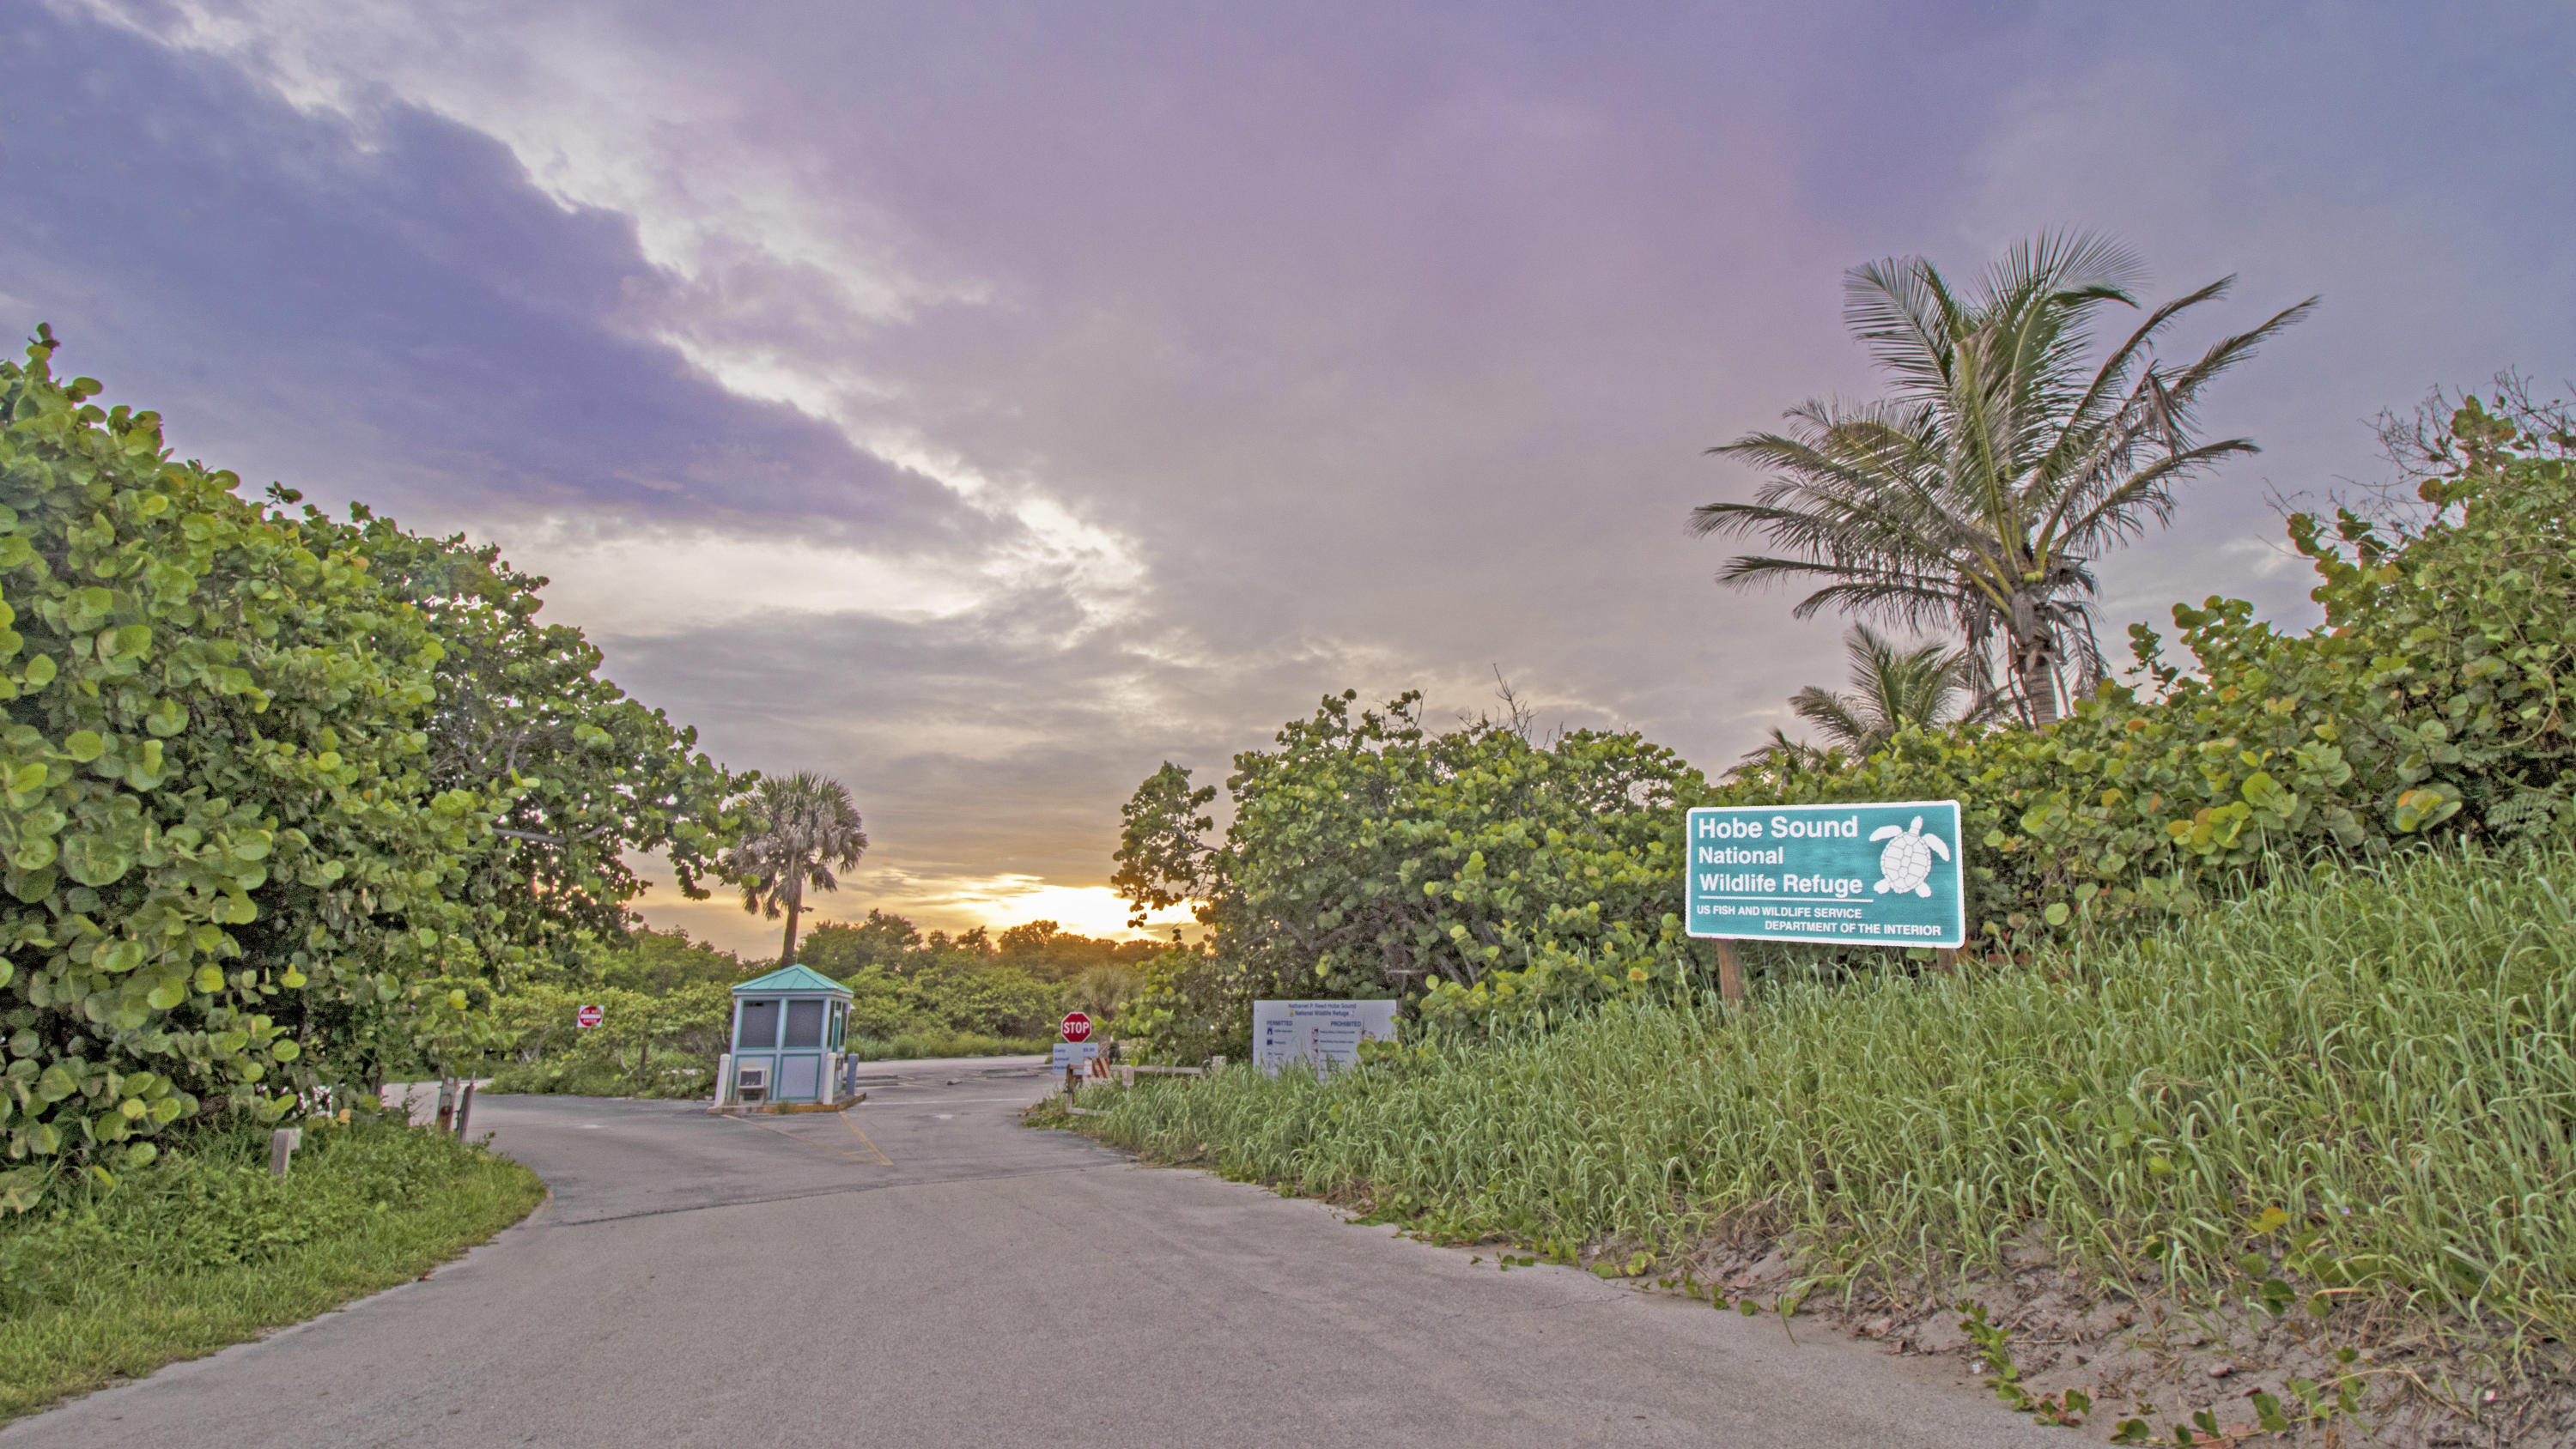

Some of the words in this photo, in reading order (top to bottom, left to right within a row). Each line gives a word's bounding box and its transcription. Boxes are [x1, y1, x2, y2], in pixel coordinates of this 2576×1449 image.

[1698, 816, 1763, 839] Hobe
[1771, 815, 1858, 839] Sound
[1698, 846, 1784, 864] National
[1699, 873, 1777, 893] Wildlife
[1783, 874, 1863, 899] Refuge
[1697, 905, 1711, 915] US
[1712, 906, 1735, 915] FISH
[1737, 906, 1760, 916] AND
[1761, 906, 1811, 918] WILDLIFE
[1814, 907, 1862, 919] SERVICE
[1765, 920, 1838, 933] DEPARTMENT
[1840, 923, 1857, 933] OF
[1858, 924, 1881, 934] THE
[1884, 925, 1942, 936] INTERIOR
[1063, 1022, 1090, 1034] STOP
